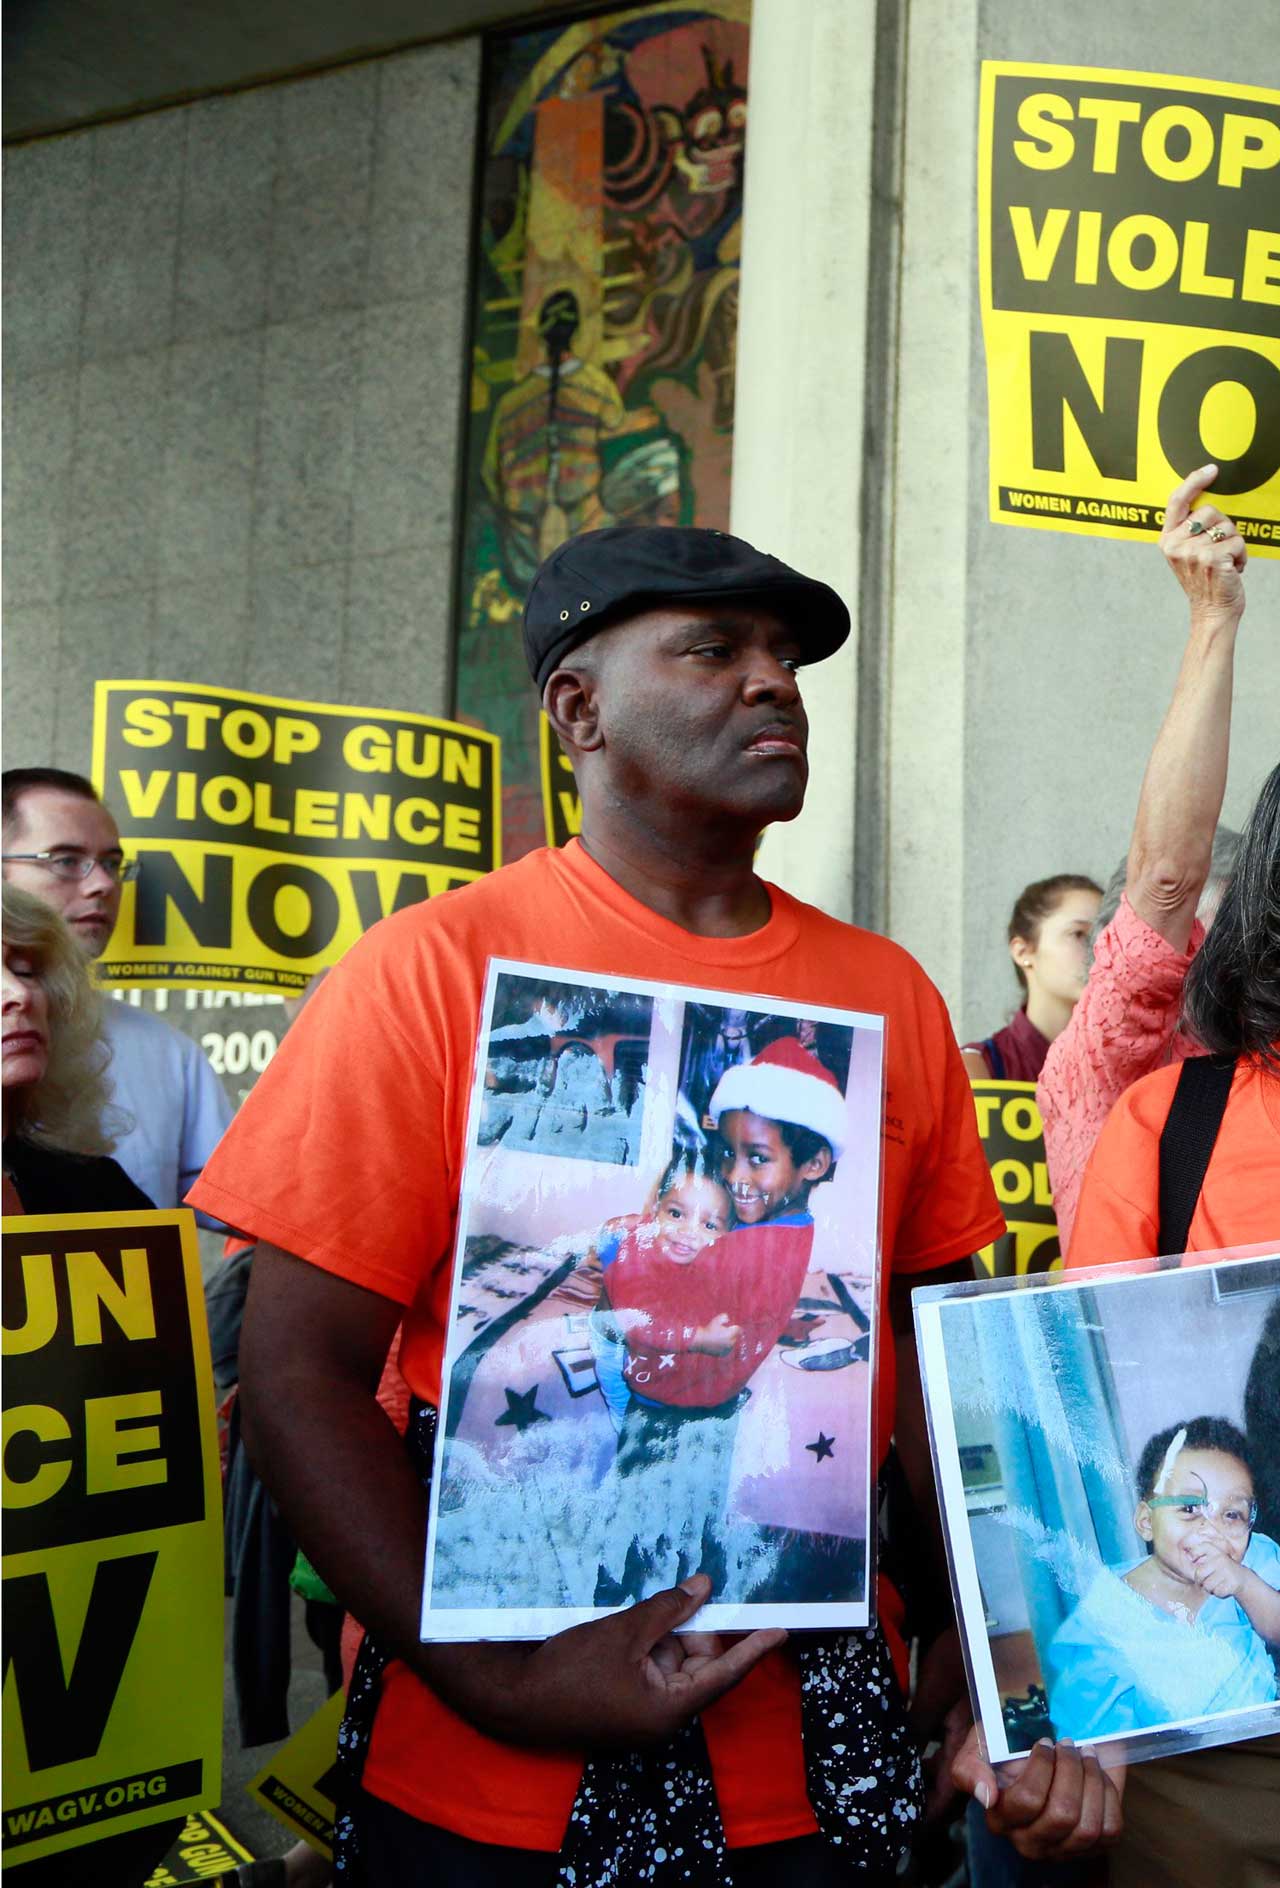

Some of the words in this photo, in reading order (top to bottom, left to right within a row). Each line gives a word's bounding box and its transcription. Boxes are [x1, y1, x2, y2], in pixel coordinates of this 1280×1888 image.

[1008, 491, 1071, 513] WOMEN
[1076, 500, 1149, 524] AGAINST
[121, 697, 321, 765] STOP
[343, 724, 482, 790] GUN
[118, 768, 482, 854] VIOLENCE
[107, 962, 170, 977] WOMEN
[173, 963, 240, 979] AGAINST
[244, 968, 275, 982] GUN
[2, 1249, 157, 1357] UN
[2, 1775, 168, 1840] .WAGV.ORG
[272, 1785, 325, 1834] WOMEN
